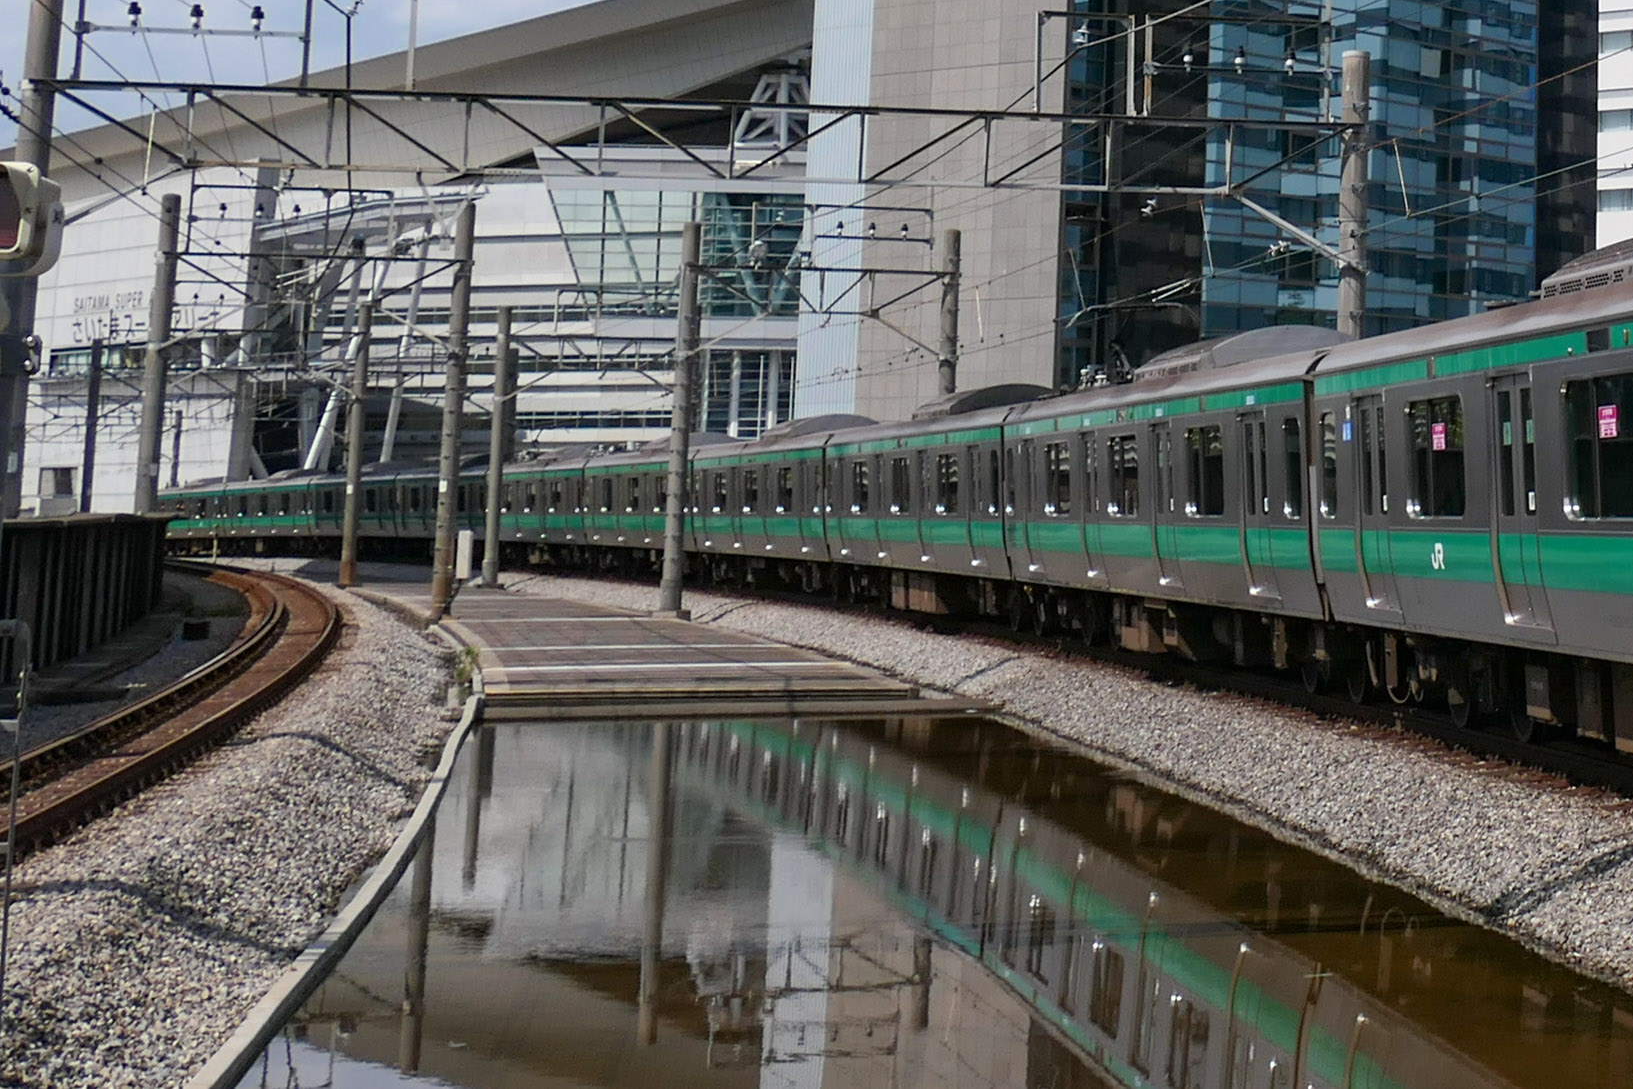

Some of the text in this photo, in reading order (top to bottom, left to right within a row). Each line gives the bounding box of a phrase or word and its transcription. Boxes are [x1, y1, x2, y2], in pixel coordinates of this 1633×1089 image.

[74, 290, 144, 313] SAITAMA SUPER
[73, 306, 219, 343] さいたまスーアリーナ
[1431, 542, 1446, 570] JR
